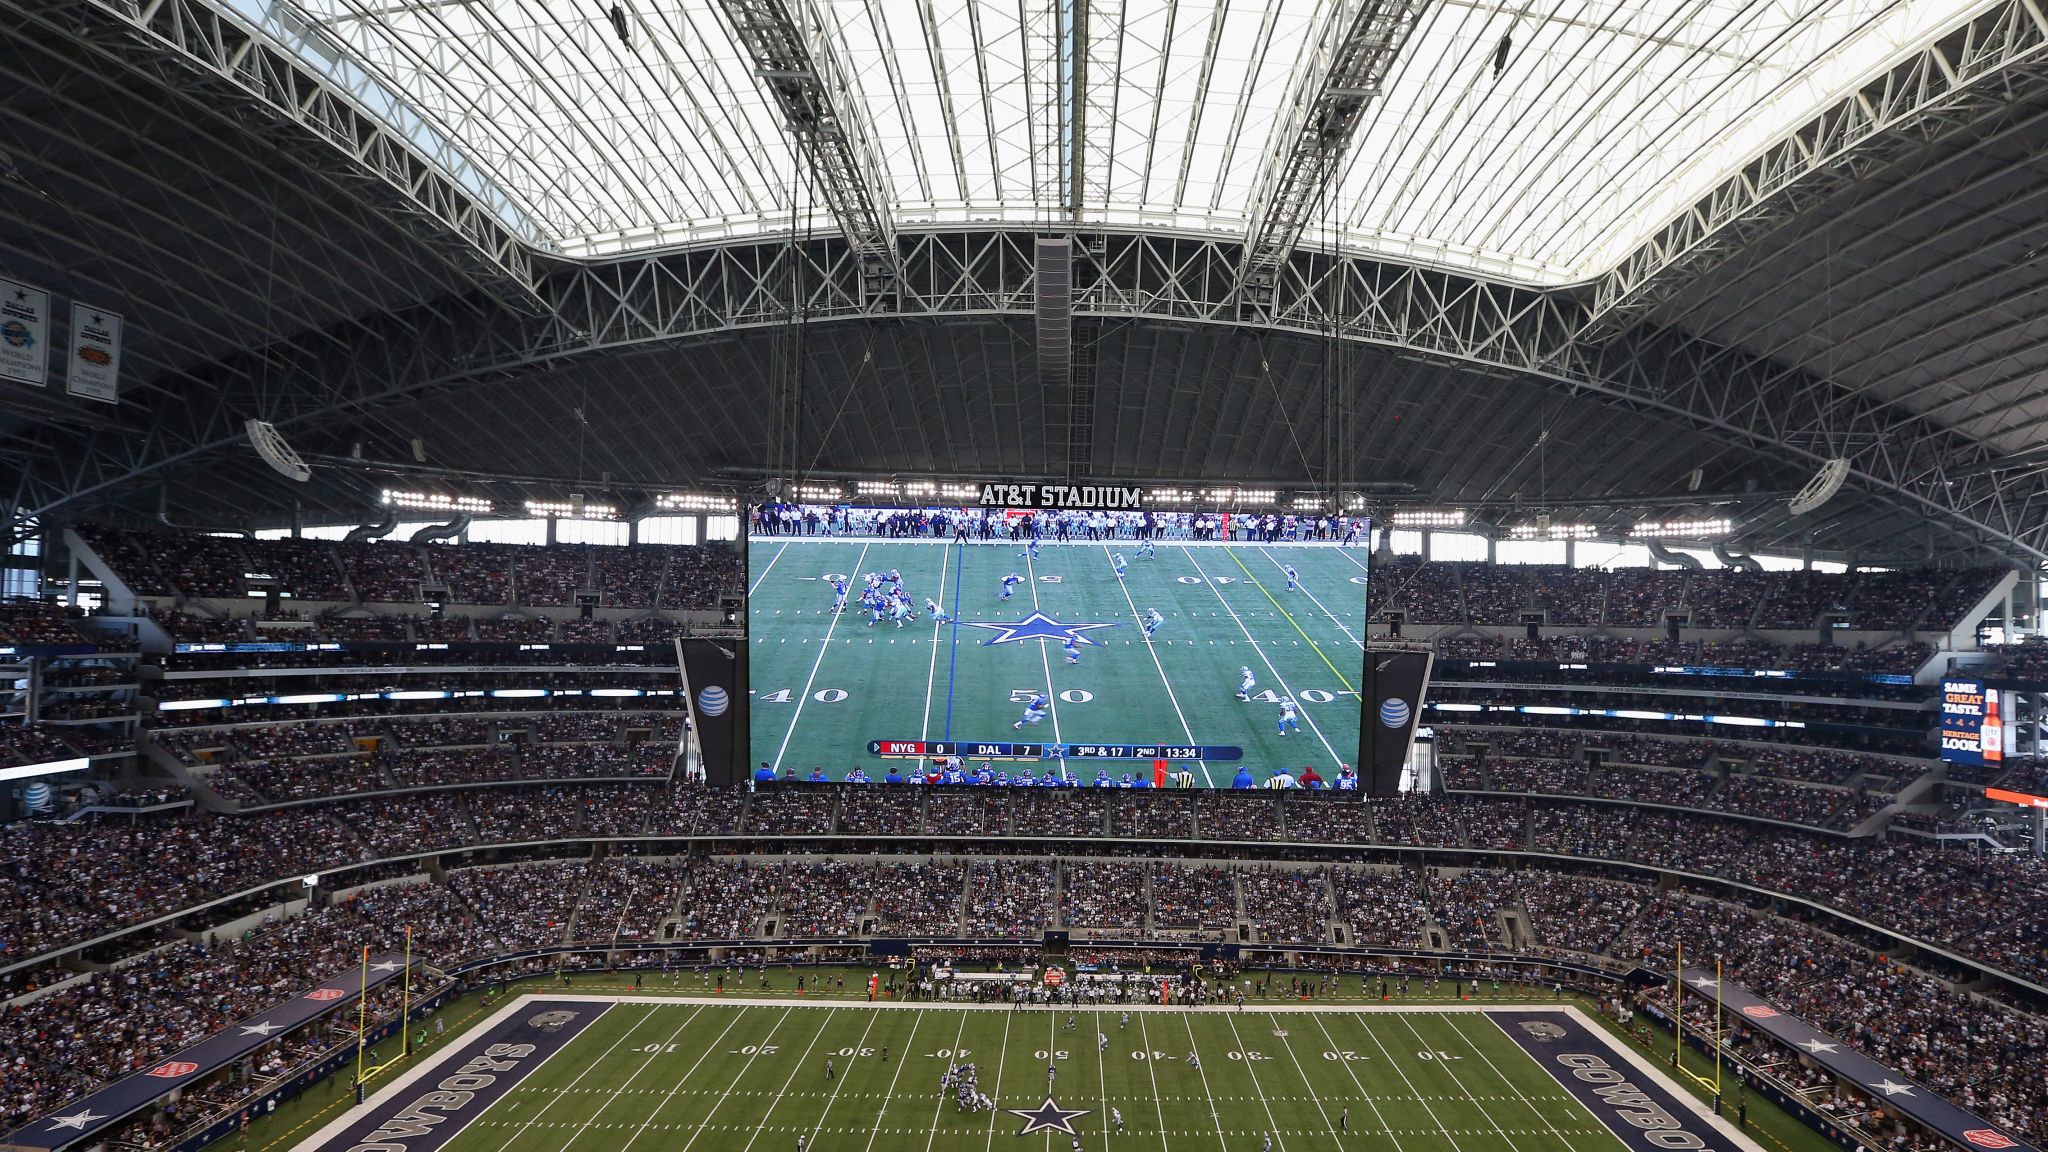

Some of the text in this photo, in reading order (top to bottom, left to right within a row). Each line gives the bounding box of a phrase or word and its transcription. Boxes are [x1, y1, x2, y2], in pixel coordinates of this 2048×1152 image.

[980, 484, 1140, 508] AT&T STADIUM
[1944, 682, 1977, 693] SAME
[1946, 693, 1983, 704] GREAT
[1942, 703, 1982, 715] TASTE.
[1942, 730, 1980, 740] HERITAGE
[890, 743, 943, 753] NYG 0
[978, 745, 1030, 755] DAL 7
[1942, 738, 1983, 752] LOOK.
[1078, 746, 1123, 757] 3RD & 17
[1137, 748, 1155, 757] 2ND
[1166, 748, 1196, 757] 13:34
[1557, 1054, 1715, 1152] COWBO
